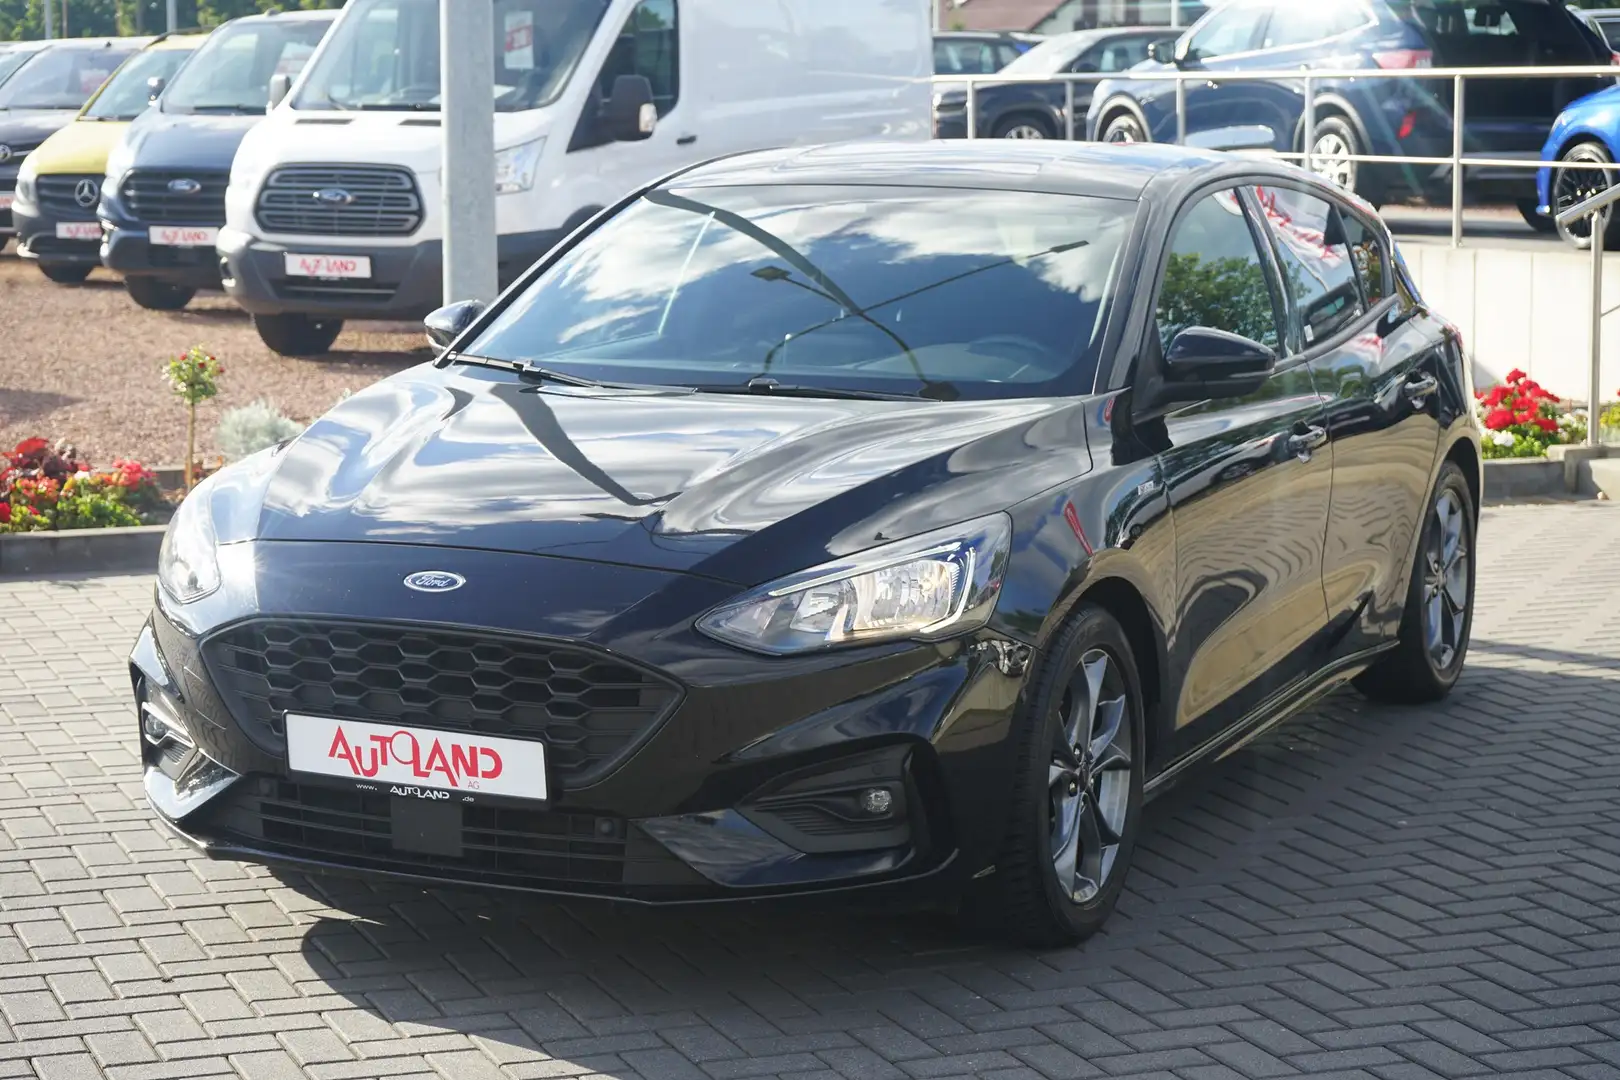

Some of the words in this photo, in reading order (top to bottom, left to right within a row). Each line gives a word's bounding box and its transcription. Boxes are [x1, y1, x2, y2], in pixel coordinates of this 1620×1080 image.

[161, 228, 209, 244] AUTLAND
[328, 725, 503, 788] AUTOLAND
[355, 783, 378, 791] www.
[389, 785, 450, 800] AUTOLAND
[462, 795, 475, 803] .de
[467, 780, 480, 790] AG
